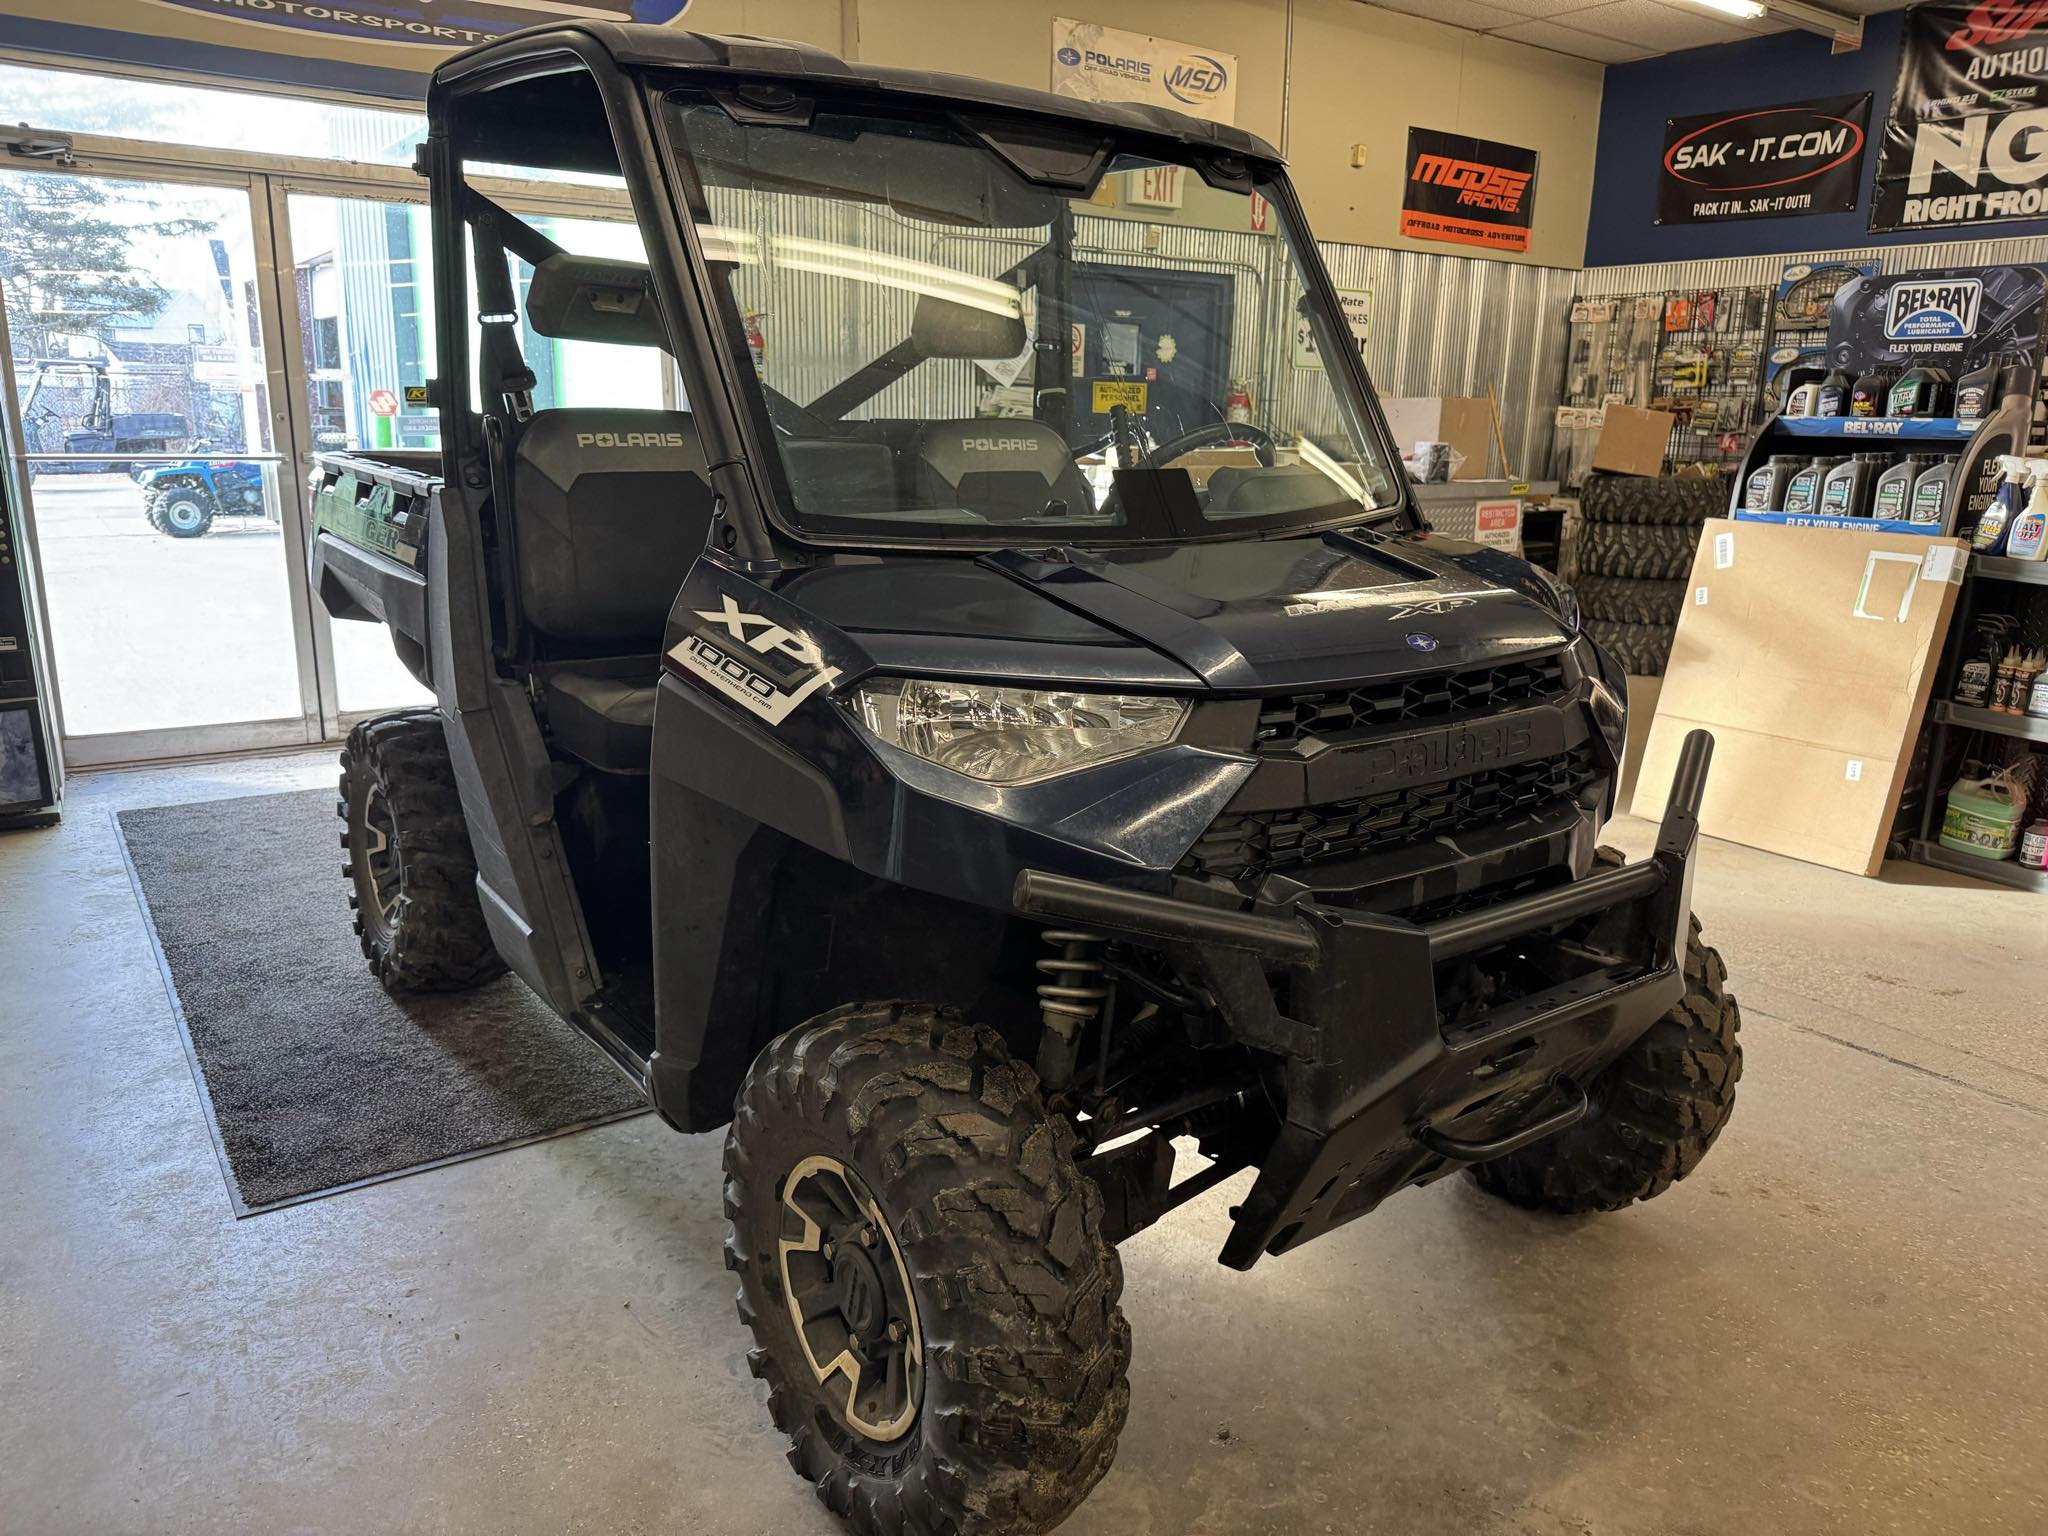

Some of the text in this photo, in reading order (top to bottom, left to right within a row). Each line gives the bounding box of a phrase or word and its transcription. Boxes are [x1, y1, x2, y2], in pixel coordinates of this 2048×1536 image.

[1084, 50, 1152, 75] POLARIS
[1965, 47, 2048, 80] AUTHO
[1120, 72, 1152, 83] VEHICLES
[1169, 65, 1225, 93] MSD
[1673, 142, 1732, 170] SAK
[1750, 128, 1847, 162] IT.COM
[1907, 108, 2048, 195] NG
[1143, 166, 1178, 203] EXIT
[1411, 153, 1533, 199] MOOSE
[1457, 189, 1518, 213] RACING
[1693, 202, 1719, 217] PACK
[1720, 201, 1731, 215] IT
[1750, 196, 1785, 212] SAK-IT
[1786, 194, 1811, 210] OUT!!
[1903, 193, 1983, 224] RIGHT
[1407, 219, 1440, 231] OFFROAD
[1442, 224, 1484, 238] MOTOCROSS
[1340, 296, 1364, 307] Rate
[1889, 343, 1964, 353] FLEX YOUR ENGINE
[576, 432, 683, 448] POLARIS
[962, 438, 1038, 451] POLARIS
[1481, 508, 1515, 517] RESTRICTED
[1490, 519, 1505, 527] AREA
[1786, 517, 1880, 532] FLEX YOUR ENGINE
[692, 593, 826, 671] XP
[687, 635, 777, 701] 1000
[690, 656, 773, 710] DUAL OVERHEAD CAM
[1371, 720, 1532, 784] POLARIS
